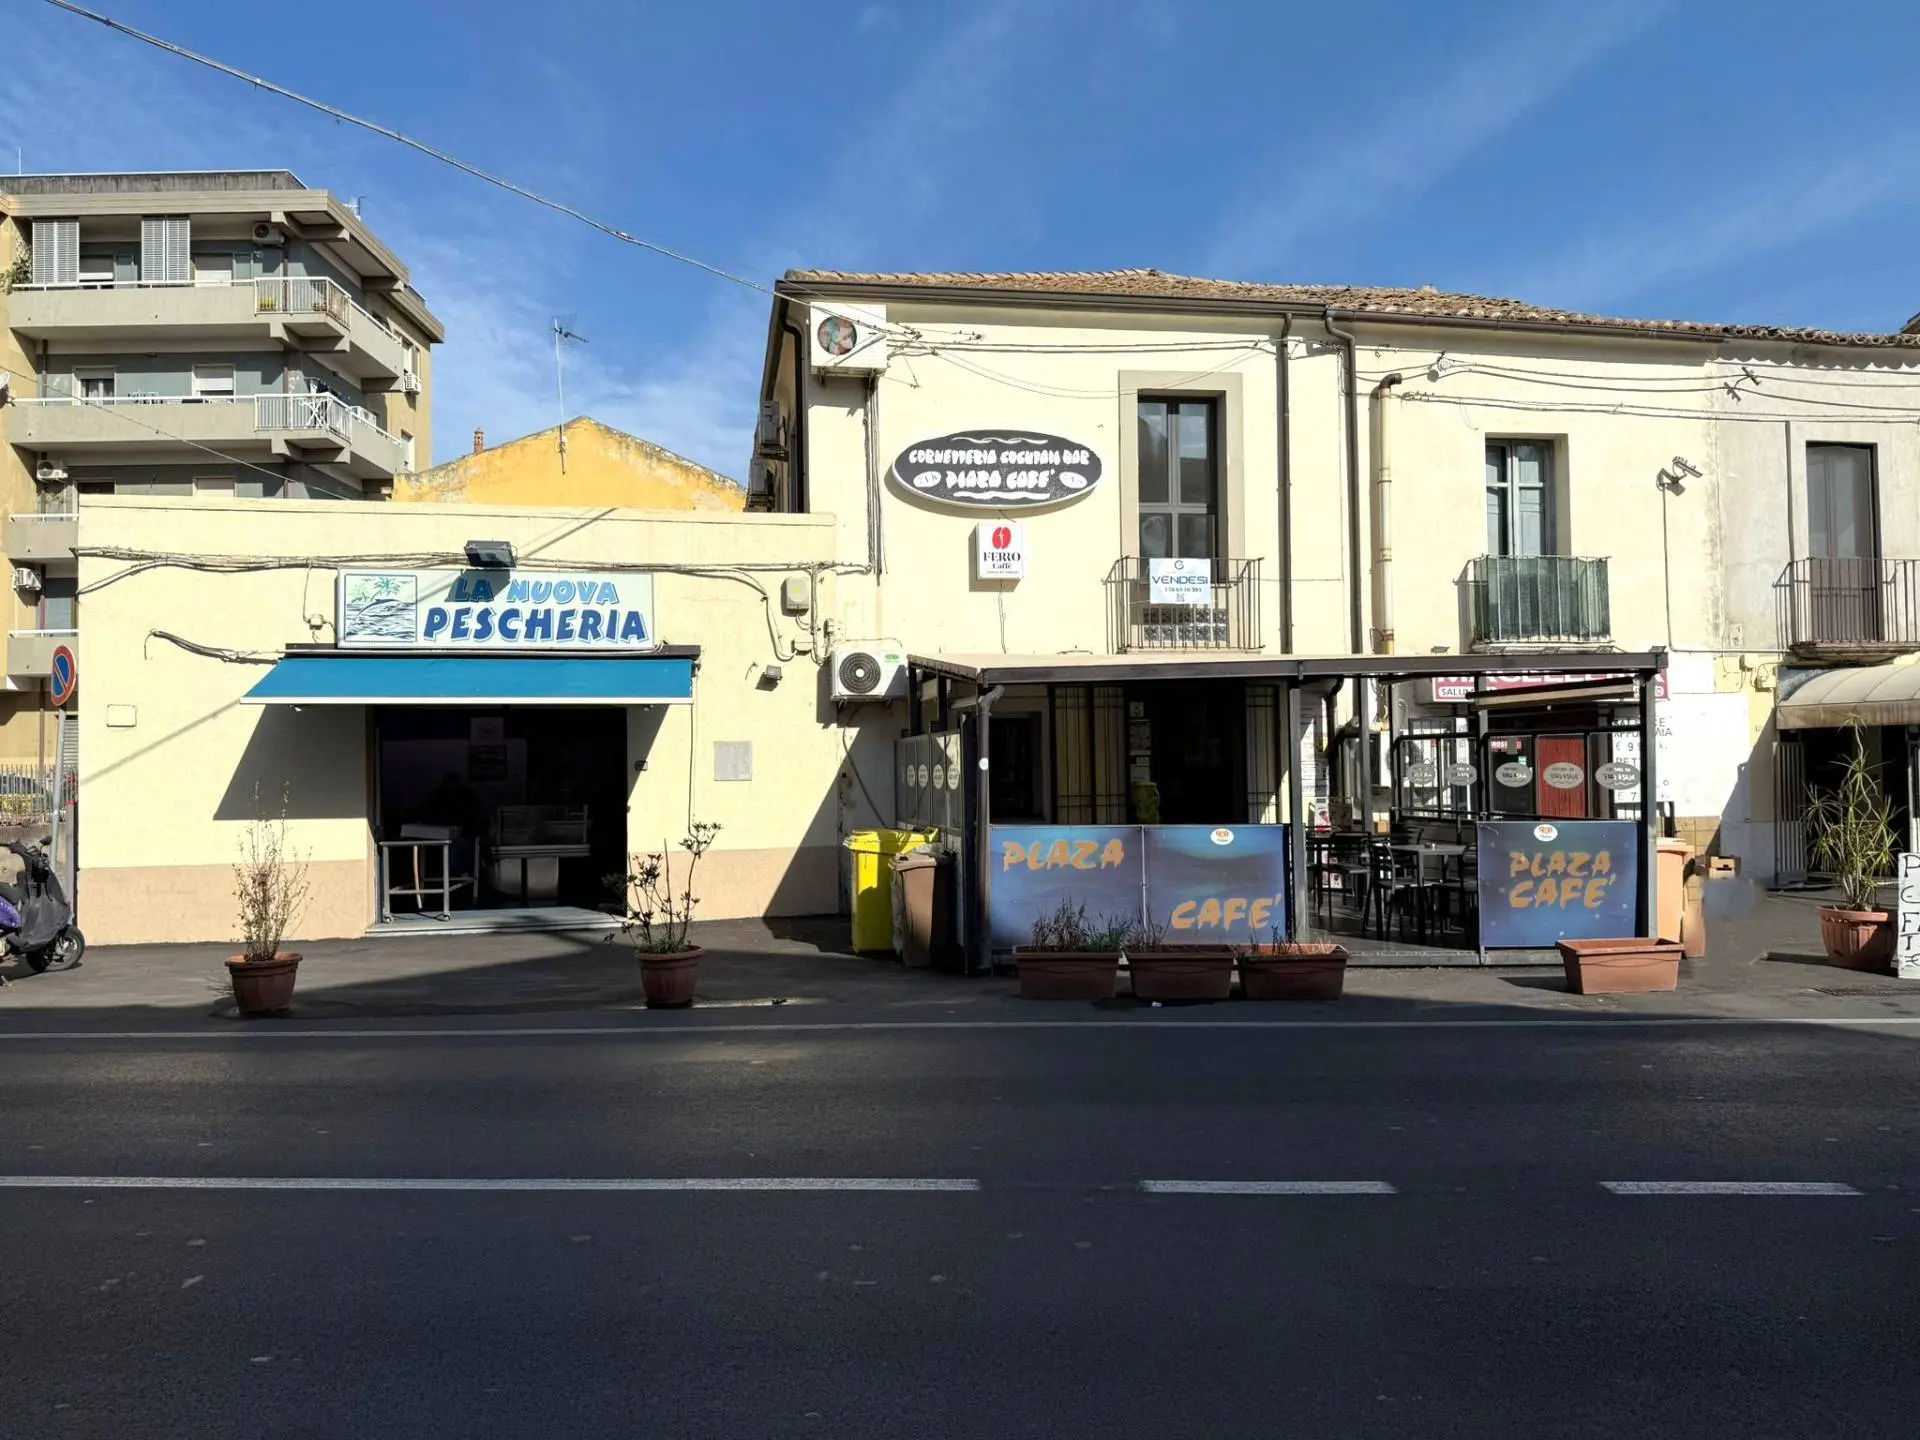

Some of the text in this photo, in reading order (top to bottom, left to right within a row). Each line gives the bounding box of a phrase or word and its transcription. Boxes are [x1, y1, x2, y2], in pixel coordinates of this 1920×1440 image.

[908, 449, 1090, 465] CORNETTERIA COCKTAIL BAR
[945, 470, 1002, 488] PLAZA
[983, 552, 1021, 562] FERRO
[452, 577, 619, 604] LA NUOVA
[1152, 575, 1208, 585] VENDESI
[423, 606, 650, 644] PESCHERIA
[1002, 838, 1125, 872] PLAZA
[1509, 850, 1612, 878] PLAZA
[1509, 873, 1617, 910] CAFE'
[1171, 893, 1283, 931] CAFE'
